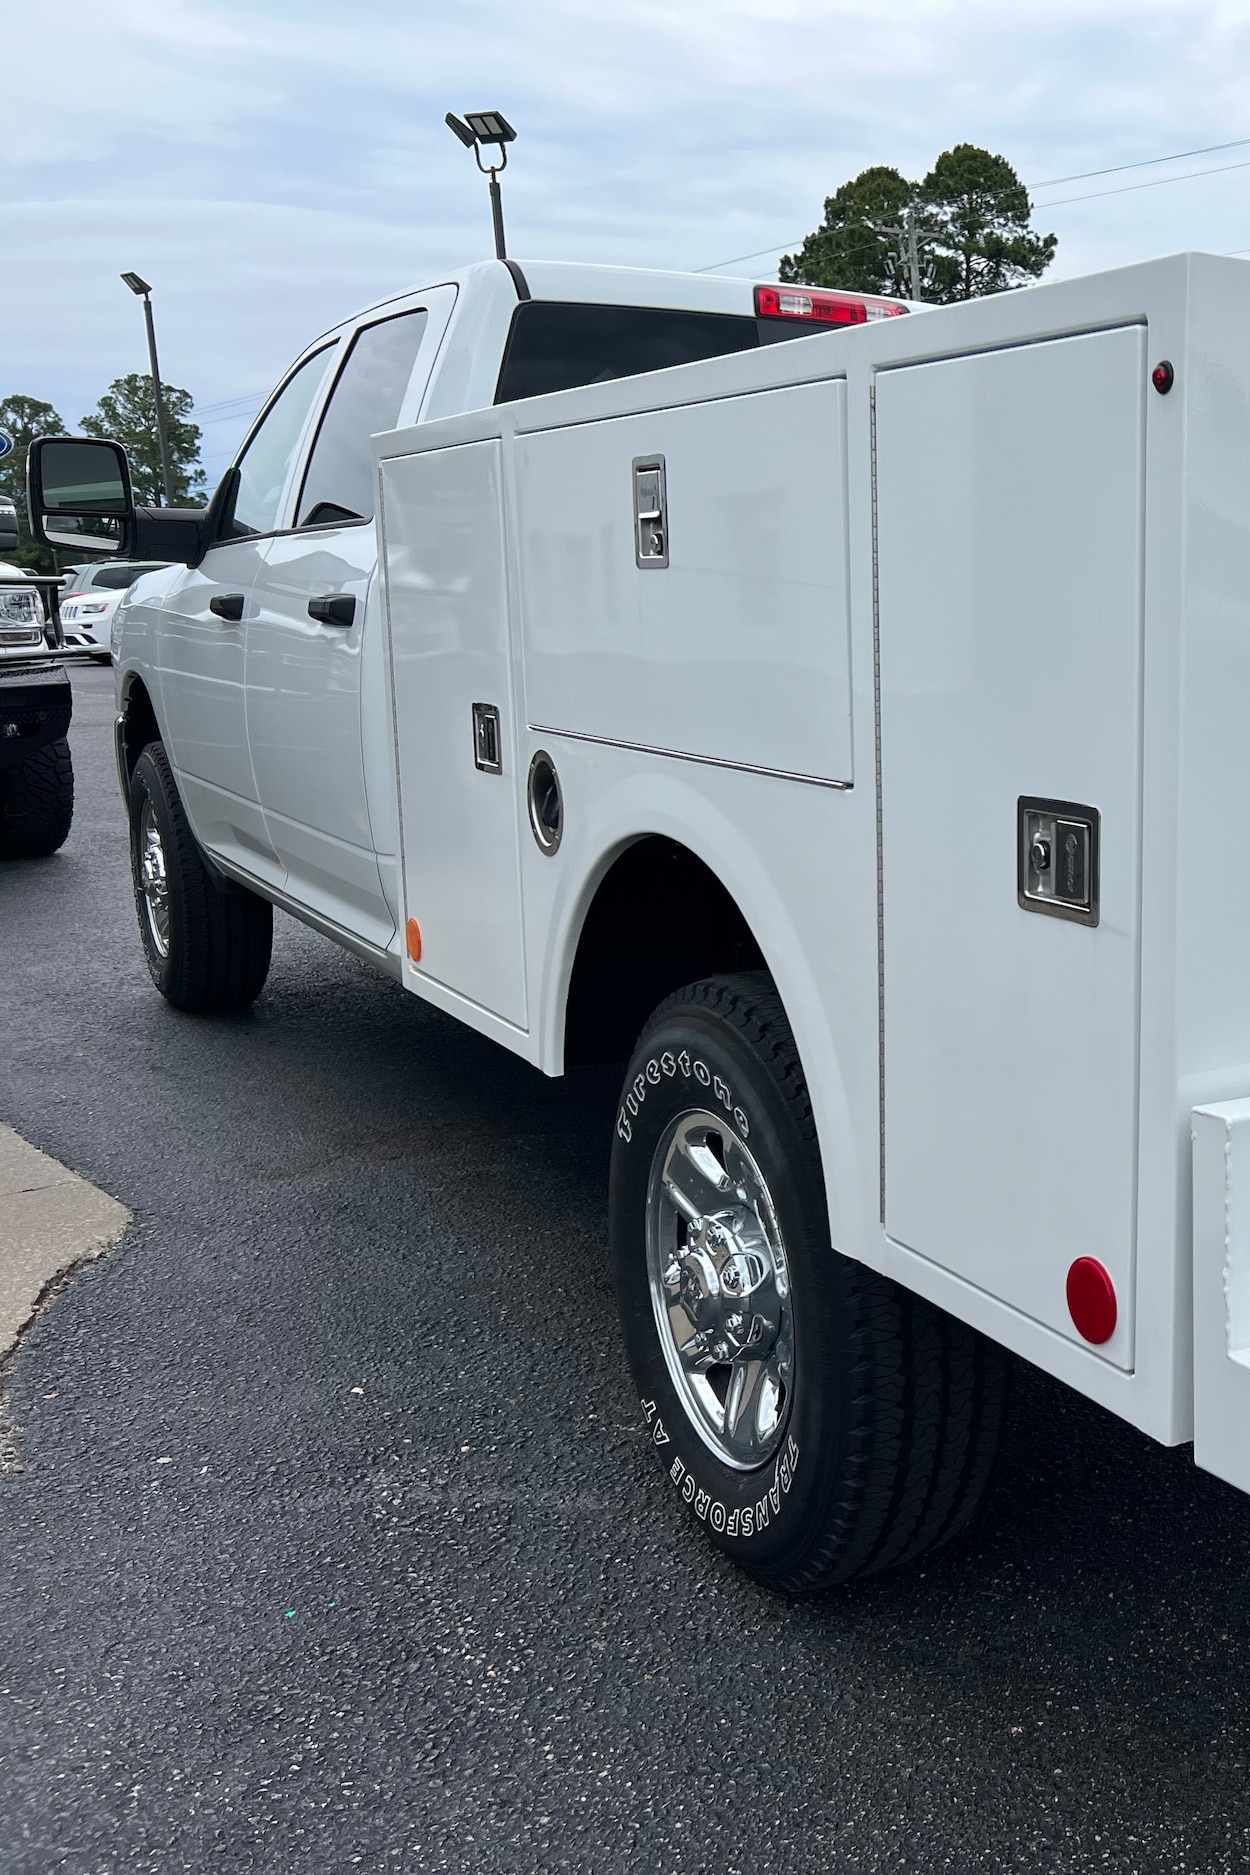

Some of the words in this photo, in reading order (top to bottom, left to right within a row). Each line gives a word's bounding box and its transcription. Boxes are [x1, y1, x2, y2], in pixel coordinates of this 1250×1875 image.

[617, 1050, 750, 1143] Firestone
[640, 1398, 671, 1446] AT
[669, 1434, 800, 1537] TRANSFORCE
